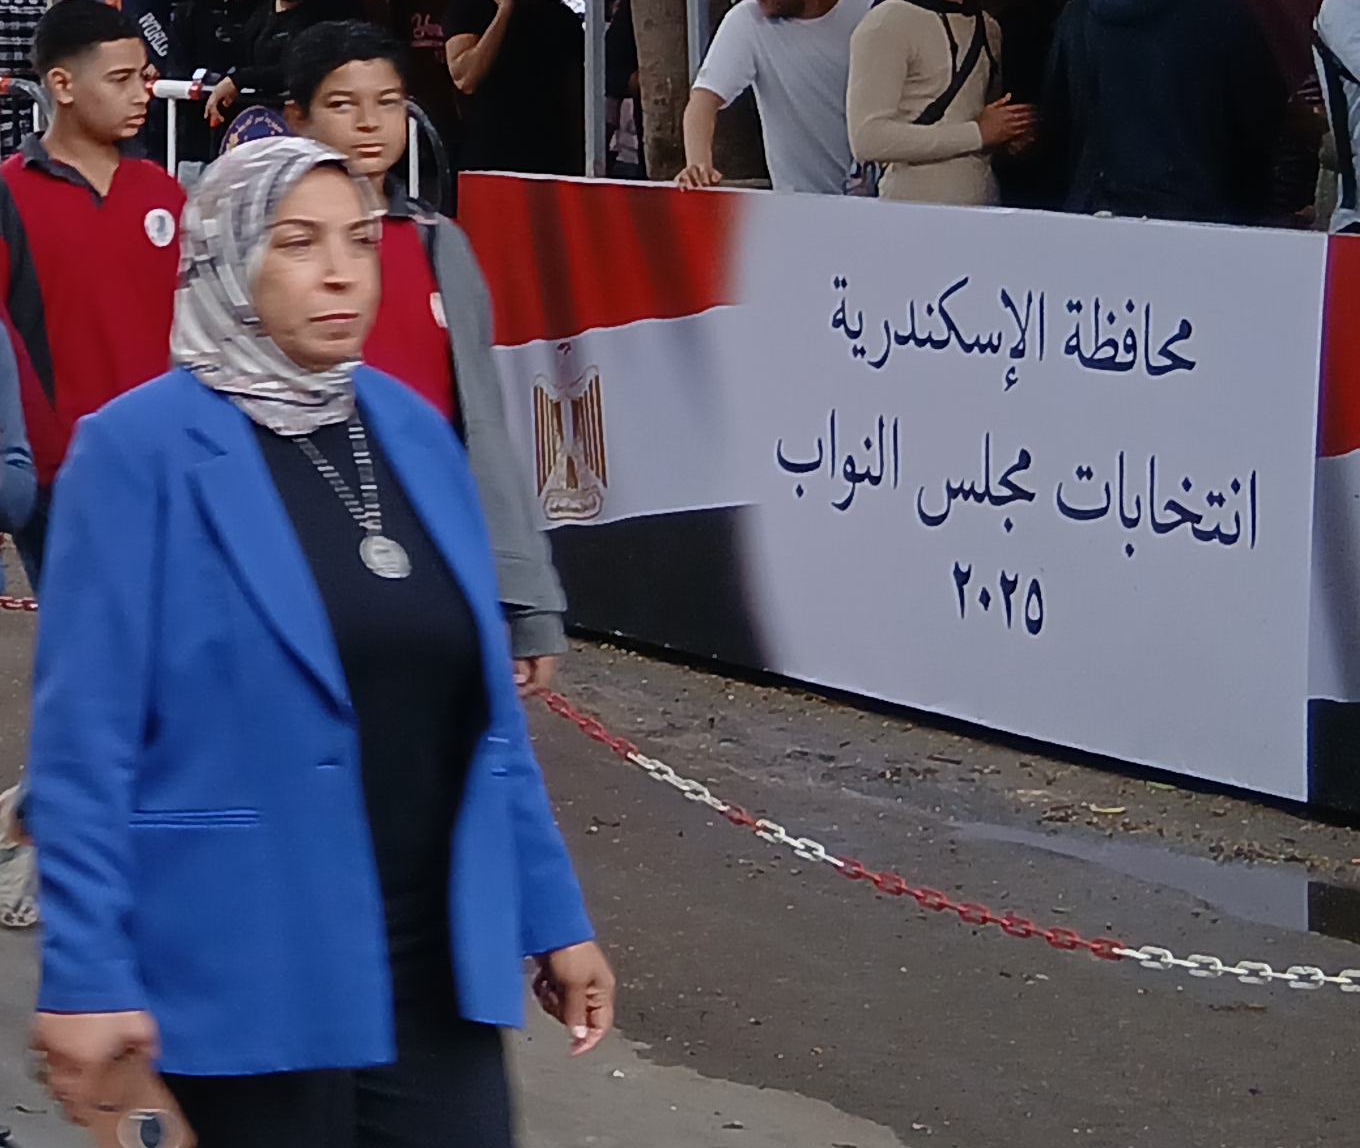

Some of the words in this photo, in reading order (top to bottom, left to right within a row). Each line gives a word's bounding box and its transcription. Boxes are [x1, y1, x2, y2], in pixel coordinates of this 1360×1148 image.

[831, 276, 1045, 392] الإسكندرية
[1063, 296, 1197, 376] محافظة
[776, 408, 900, 512] النواب
[917, 432, 1036, 533] مجلس
[1056, 451, 1257, 557] انتخابات
[952, 561, 1044, 636] ٢٠٢٥
